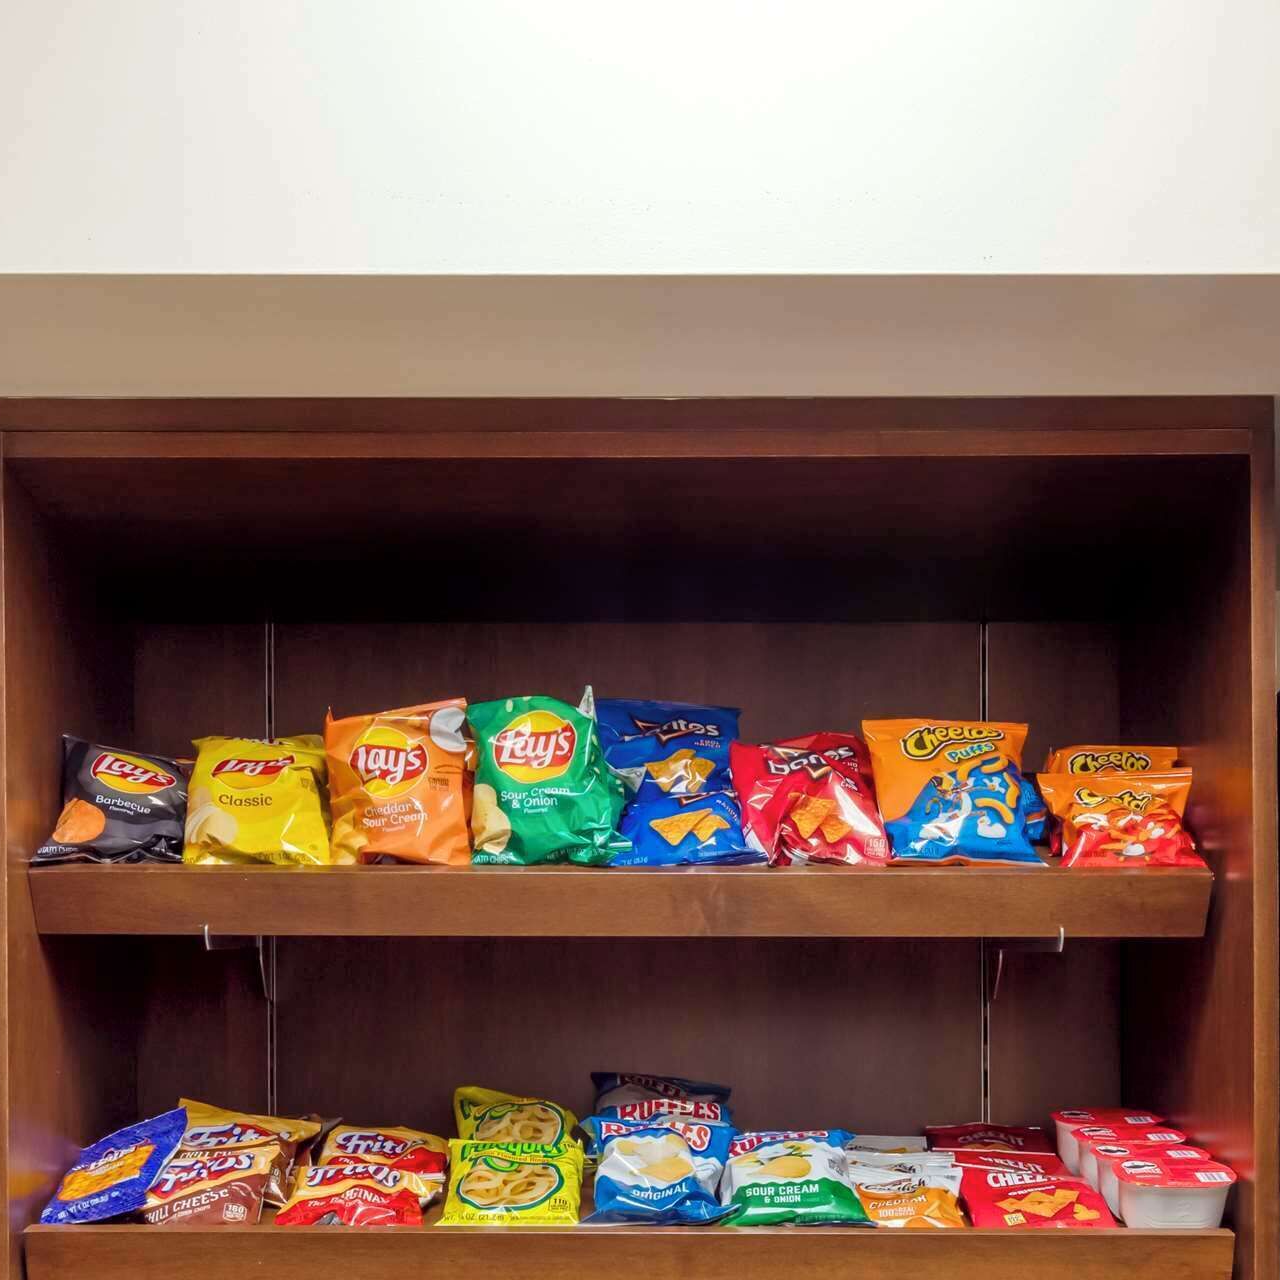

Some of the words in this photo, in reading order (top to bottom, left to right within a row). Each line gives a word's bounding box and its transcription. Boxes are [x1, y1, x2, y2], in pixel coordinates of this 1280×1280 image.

[500, 727, 571, 769] Lay's
[904, 725, 1003, 758] Cheetos
[95, 753, 171, 785] Lay's
[356, 744, 424, 784] Lay's
[95, 793, 151, 815] Barbecue
[218, 793, 273, 807] Classic
[500, 790, 529, 802] Sour
[511, 799, 521, 809] &
[523, 794, 559, 808] Onion
[364, 801, 412, 818] Cheddar
[362, 814, 389, 829] Sour
[391, 810, 429, 828] Cream
[618, 1097, 721, 1121] RUFFLES
[630, 1182, 691, 1201] ORIGINAL
[745, 1185, 775, 1197] SOUR
[778, 1183, 820, 1196] CREAM
[764, 1196, 771, 1204] &
[773, 1194, 802, 1204] ONION
[172, 1188, 231, 1212] CHEESE
